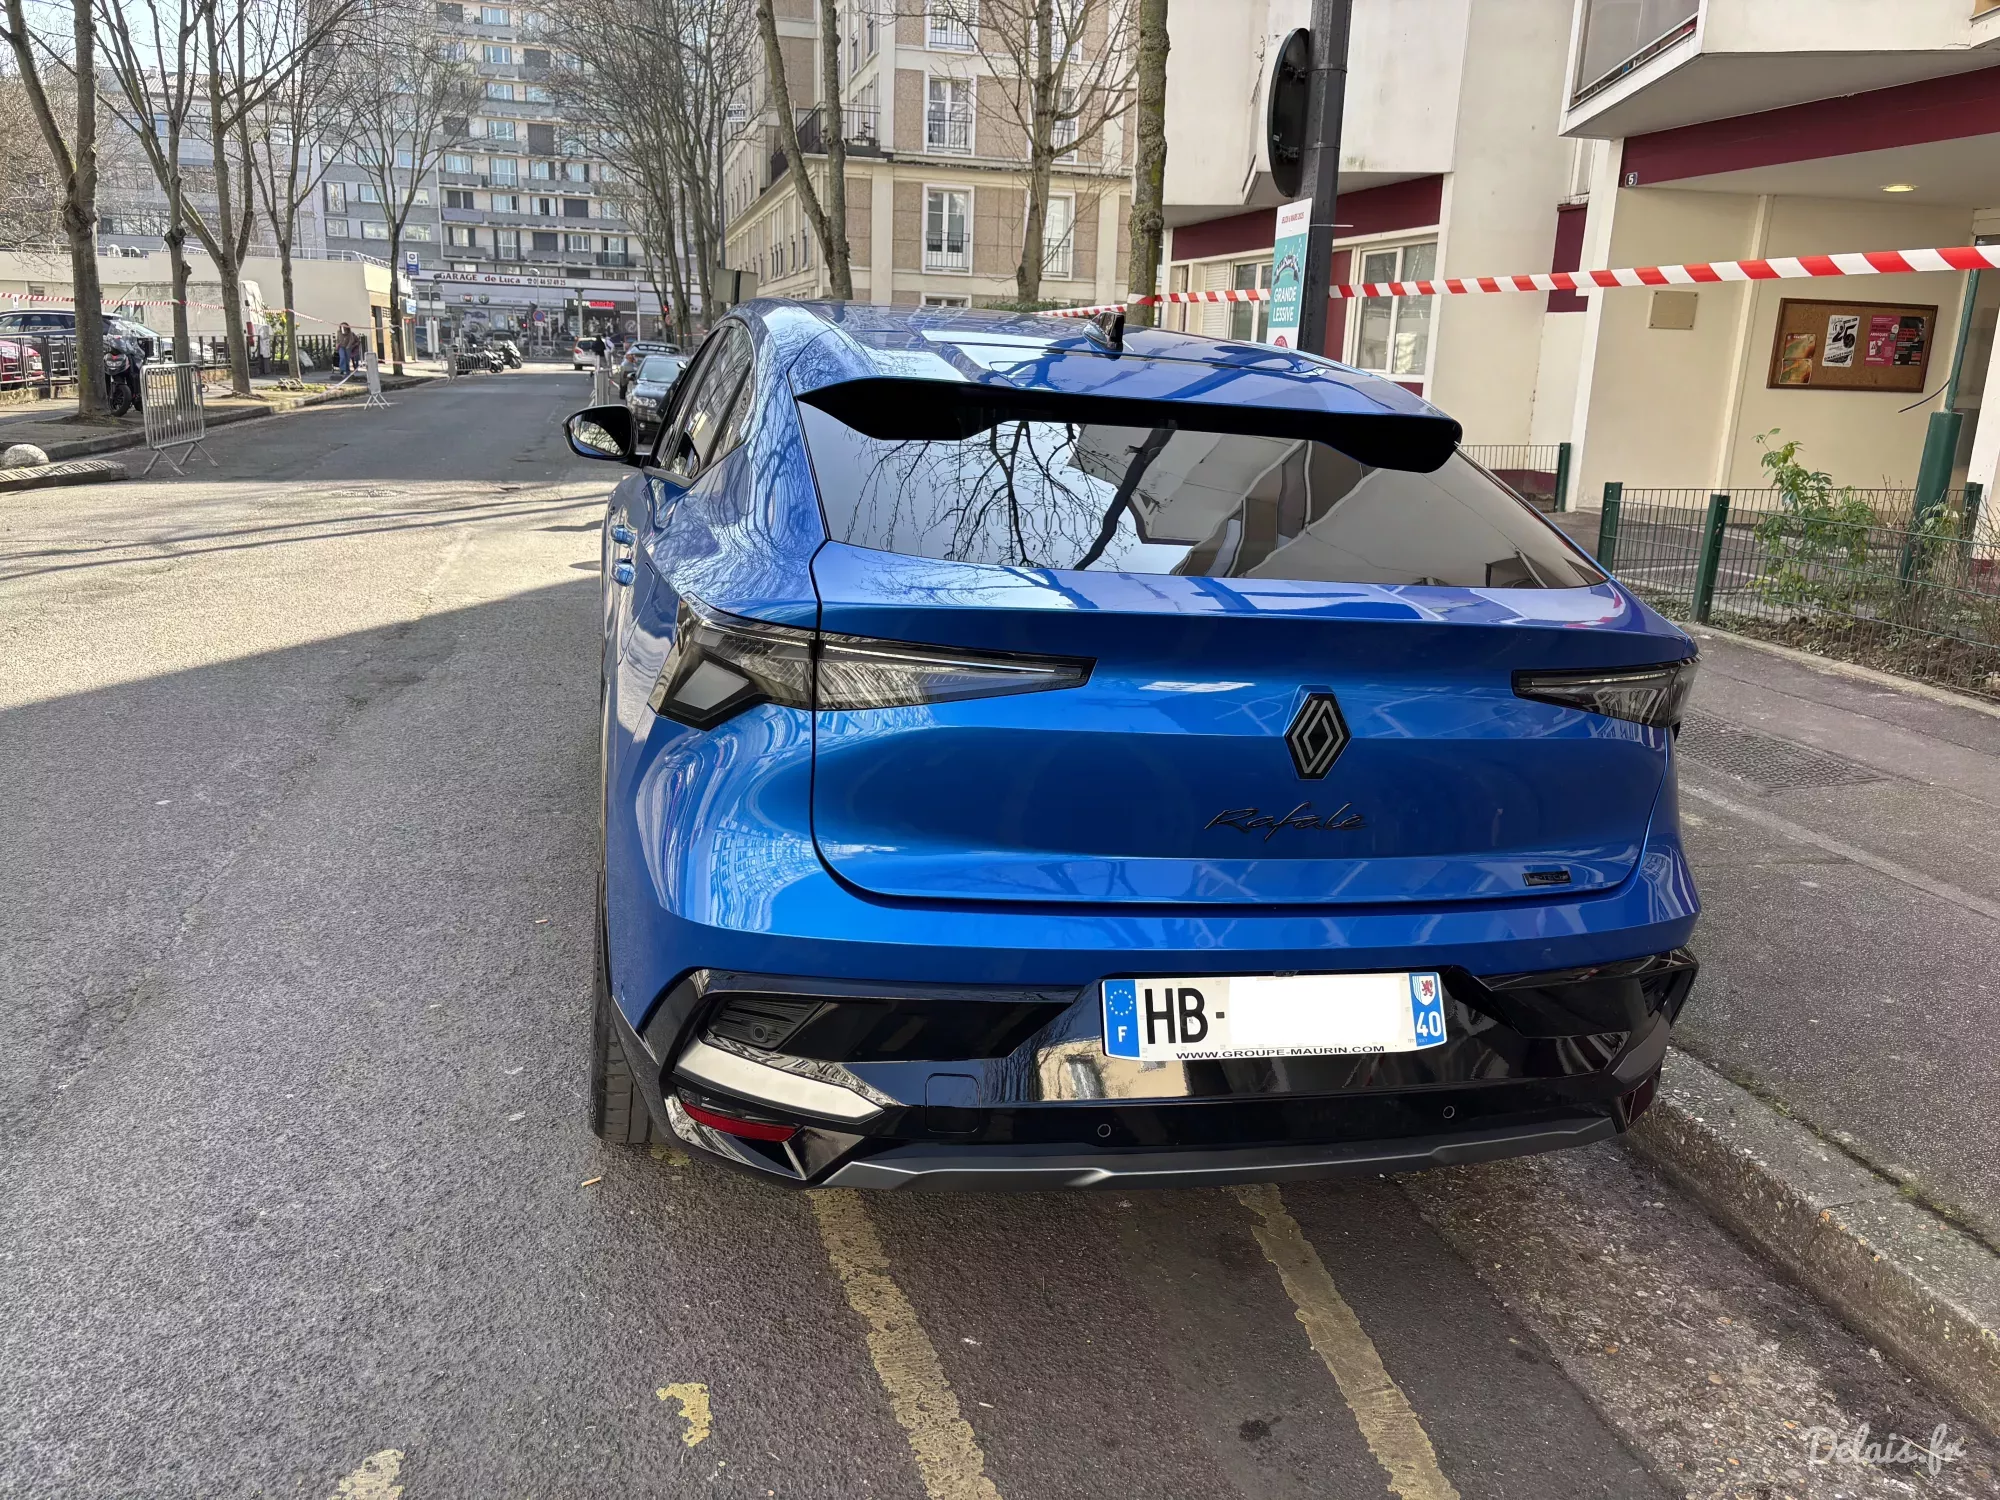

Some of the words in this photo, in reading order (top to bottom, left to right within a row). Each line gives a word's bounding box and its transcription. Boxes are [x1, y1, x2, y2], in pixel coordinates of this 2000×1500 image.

[1627, 175, 1634, 185] 5
[440, 272, 477, 281] GARAGE
[500, 276, 520, 284] Luca
[1274, 286, 1297, 303] GRANDE
[1272, 306, 1294, 322] LESSIVE
[1204, 801, 1368, 842] Rafale
[1416, 1011, 1442, 1038] 40
[1117, 1026, 1128, 1042] F
[1175, 1045, 1385, 1060] WWW.GROUPE-MAURIN.COM
